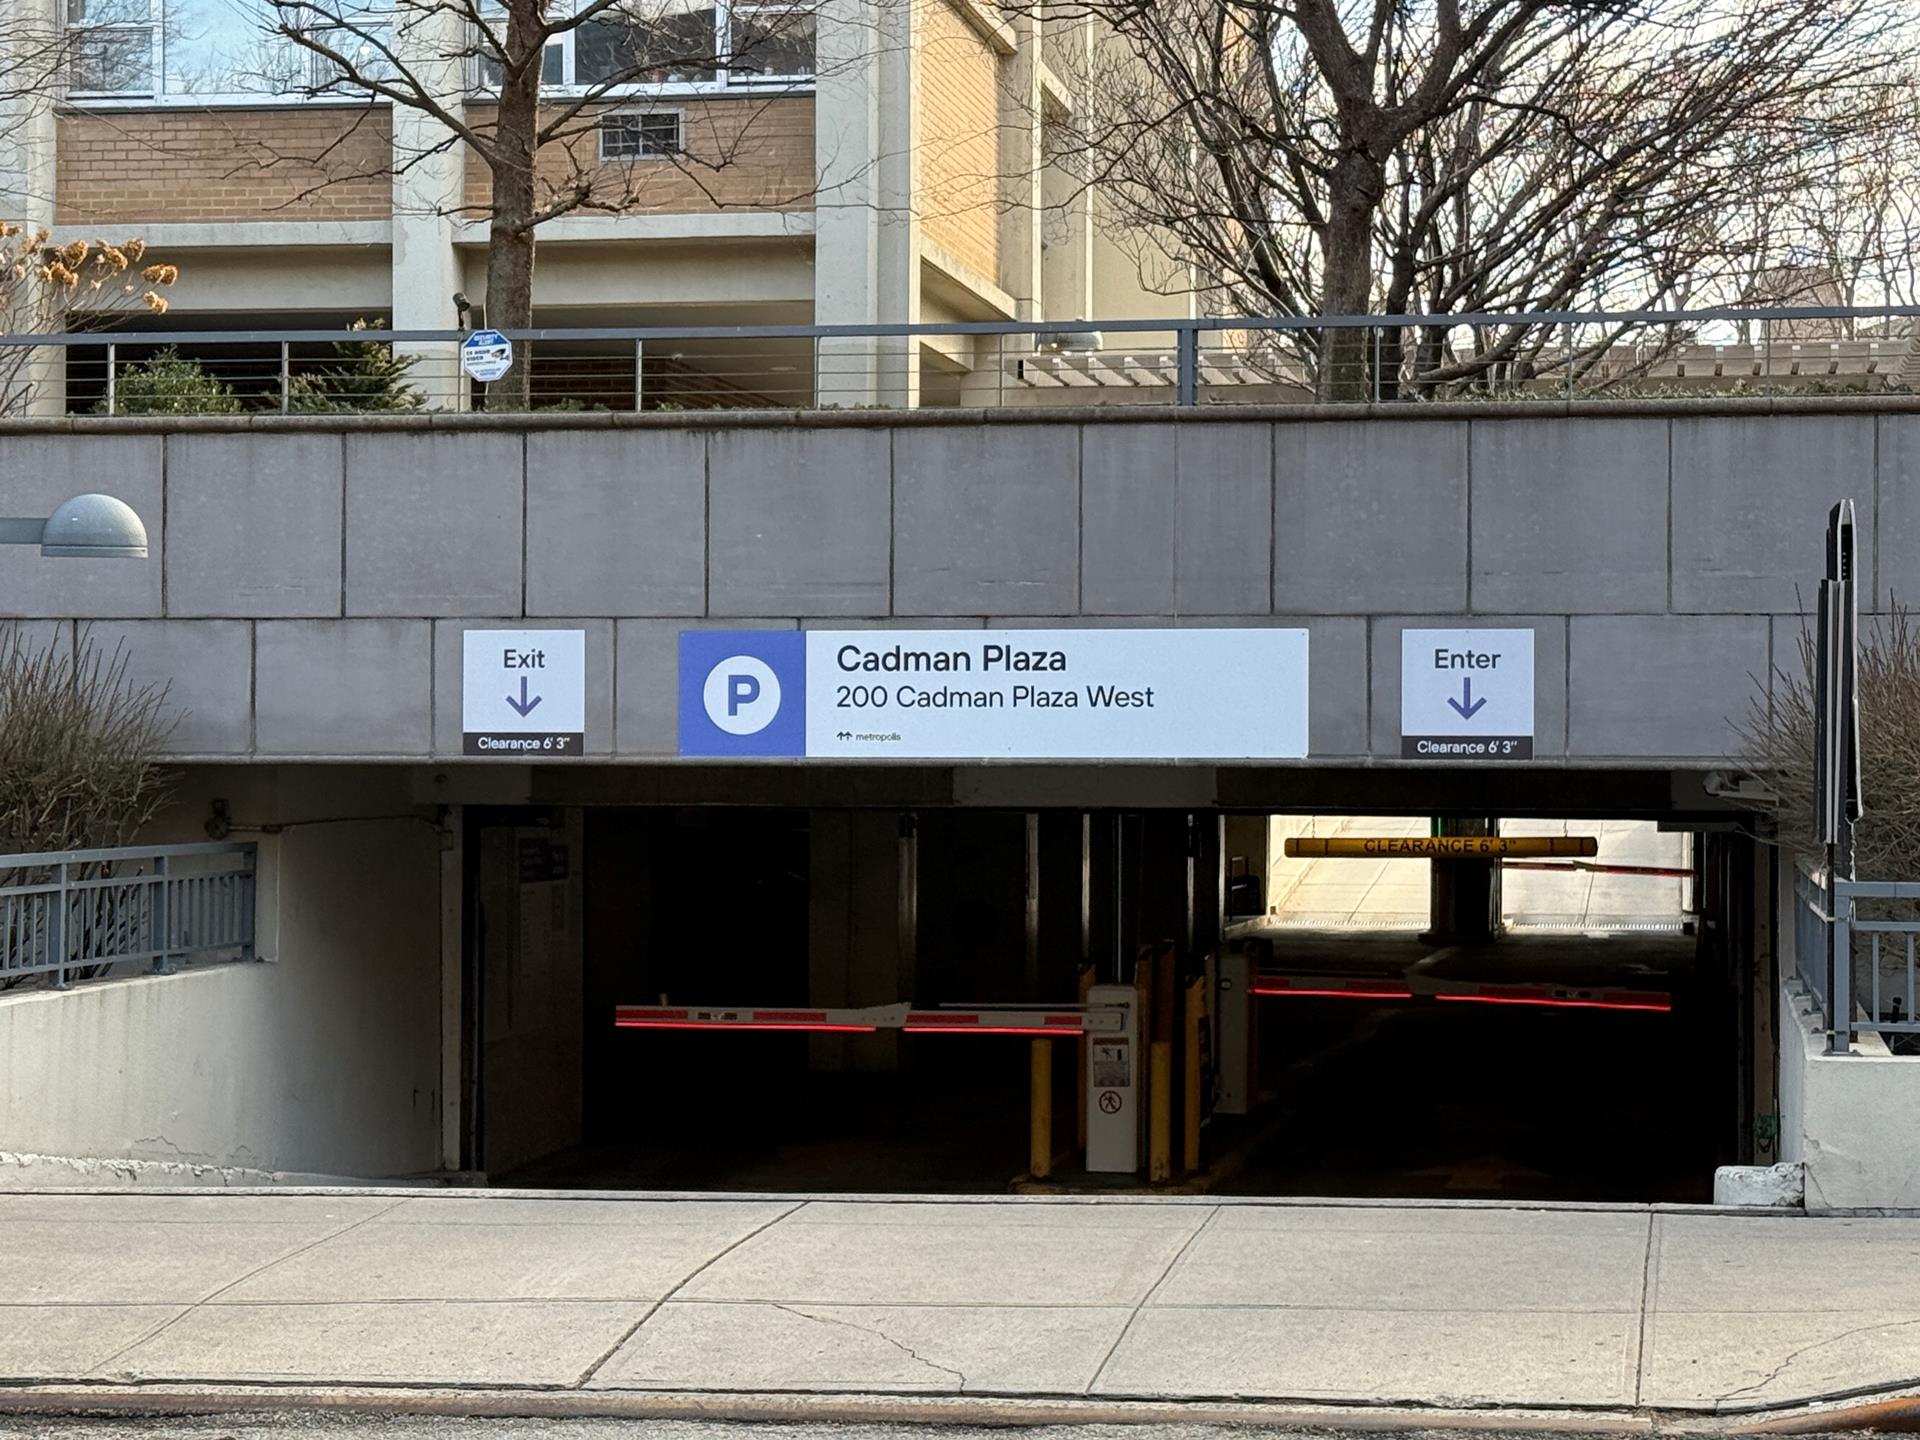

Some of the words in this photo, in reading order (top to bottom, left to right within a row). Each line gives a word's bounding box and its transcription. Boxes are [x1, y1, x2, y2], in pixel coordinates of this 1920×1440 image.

[503, 648, 545, 669] Exit
[836, 644, 971, 672] Cadman
[982, 644, 1067, 672] Plaza
[1434, 648, 1502, 669] Enter
[727, 674, 761, 716] P
[836, 685, 888, 708] 200
[896, 685, 1004, 708] Cadman
[1012, 685, 1078, 708] Plaza
[1086, 685, 1155, 708] West
[477, 736, 541, 750] Clearance
[855, 732, 902, 743] metropolis
[1416, 740, 1485, 754] Clearance
[1488, 740, 1500, 754] 6'
[1502, 740, 1518, 754] 3"
[1364, 838, 1473, 852] CLEARANCE
[1479, 839, 1494, 852] 6'
